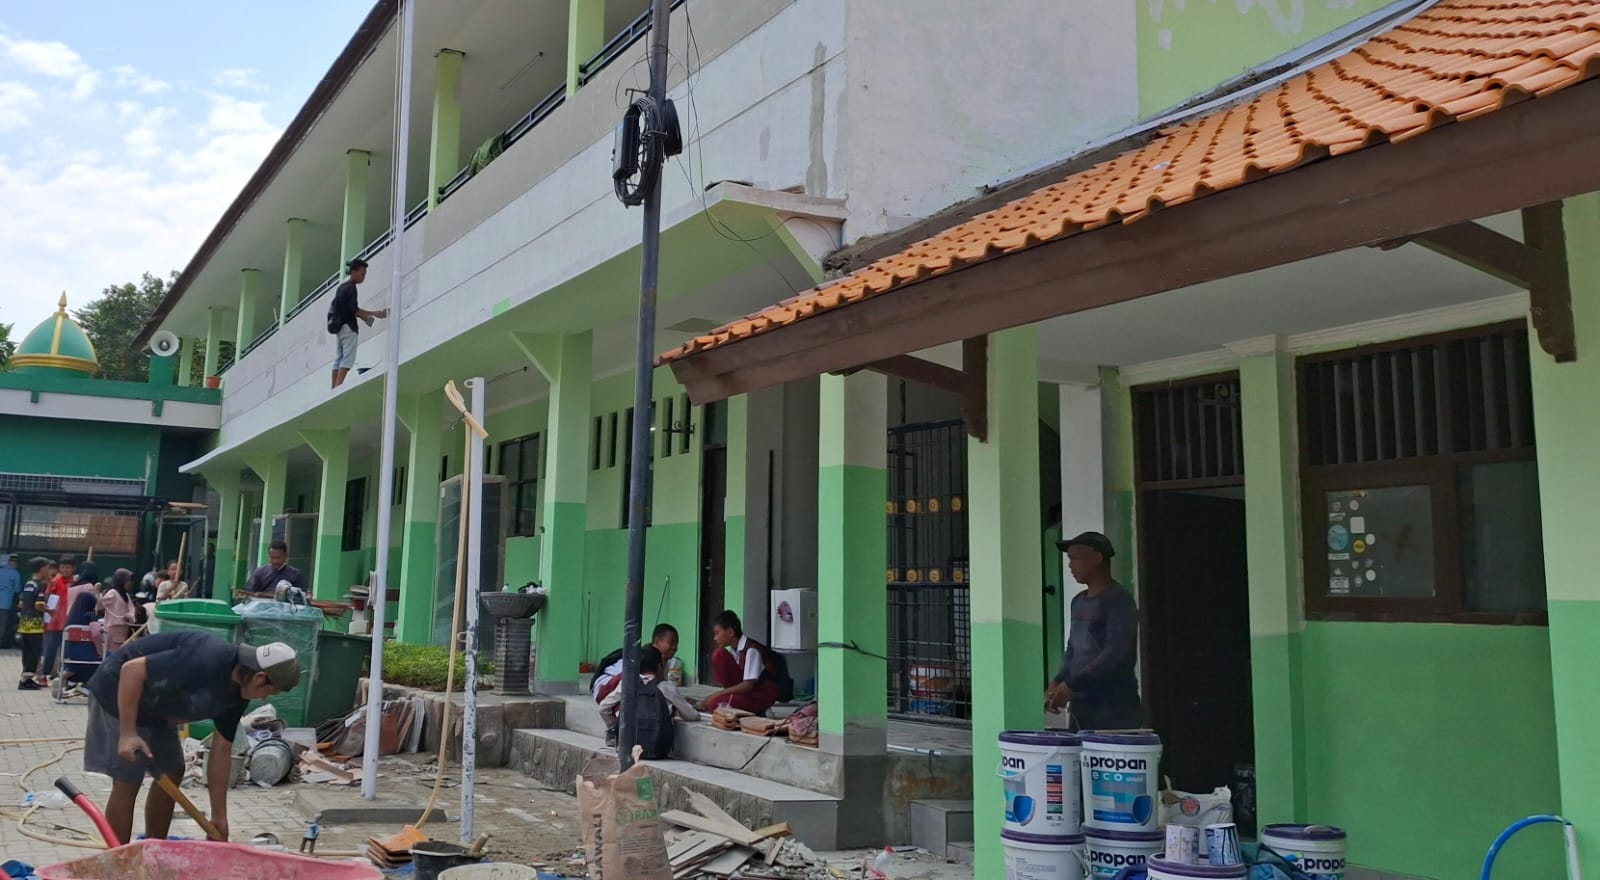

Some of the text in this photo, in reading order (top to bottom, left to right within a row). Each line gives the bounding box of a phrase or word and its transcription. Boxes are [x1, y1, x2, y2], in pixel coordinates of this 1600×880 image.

[1089, 756, 1147, 771] propan
[1092, 771, 1122, 782] eco
[1090, 850, 1146, 867] propan
